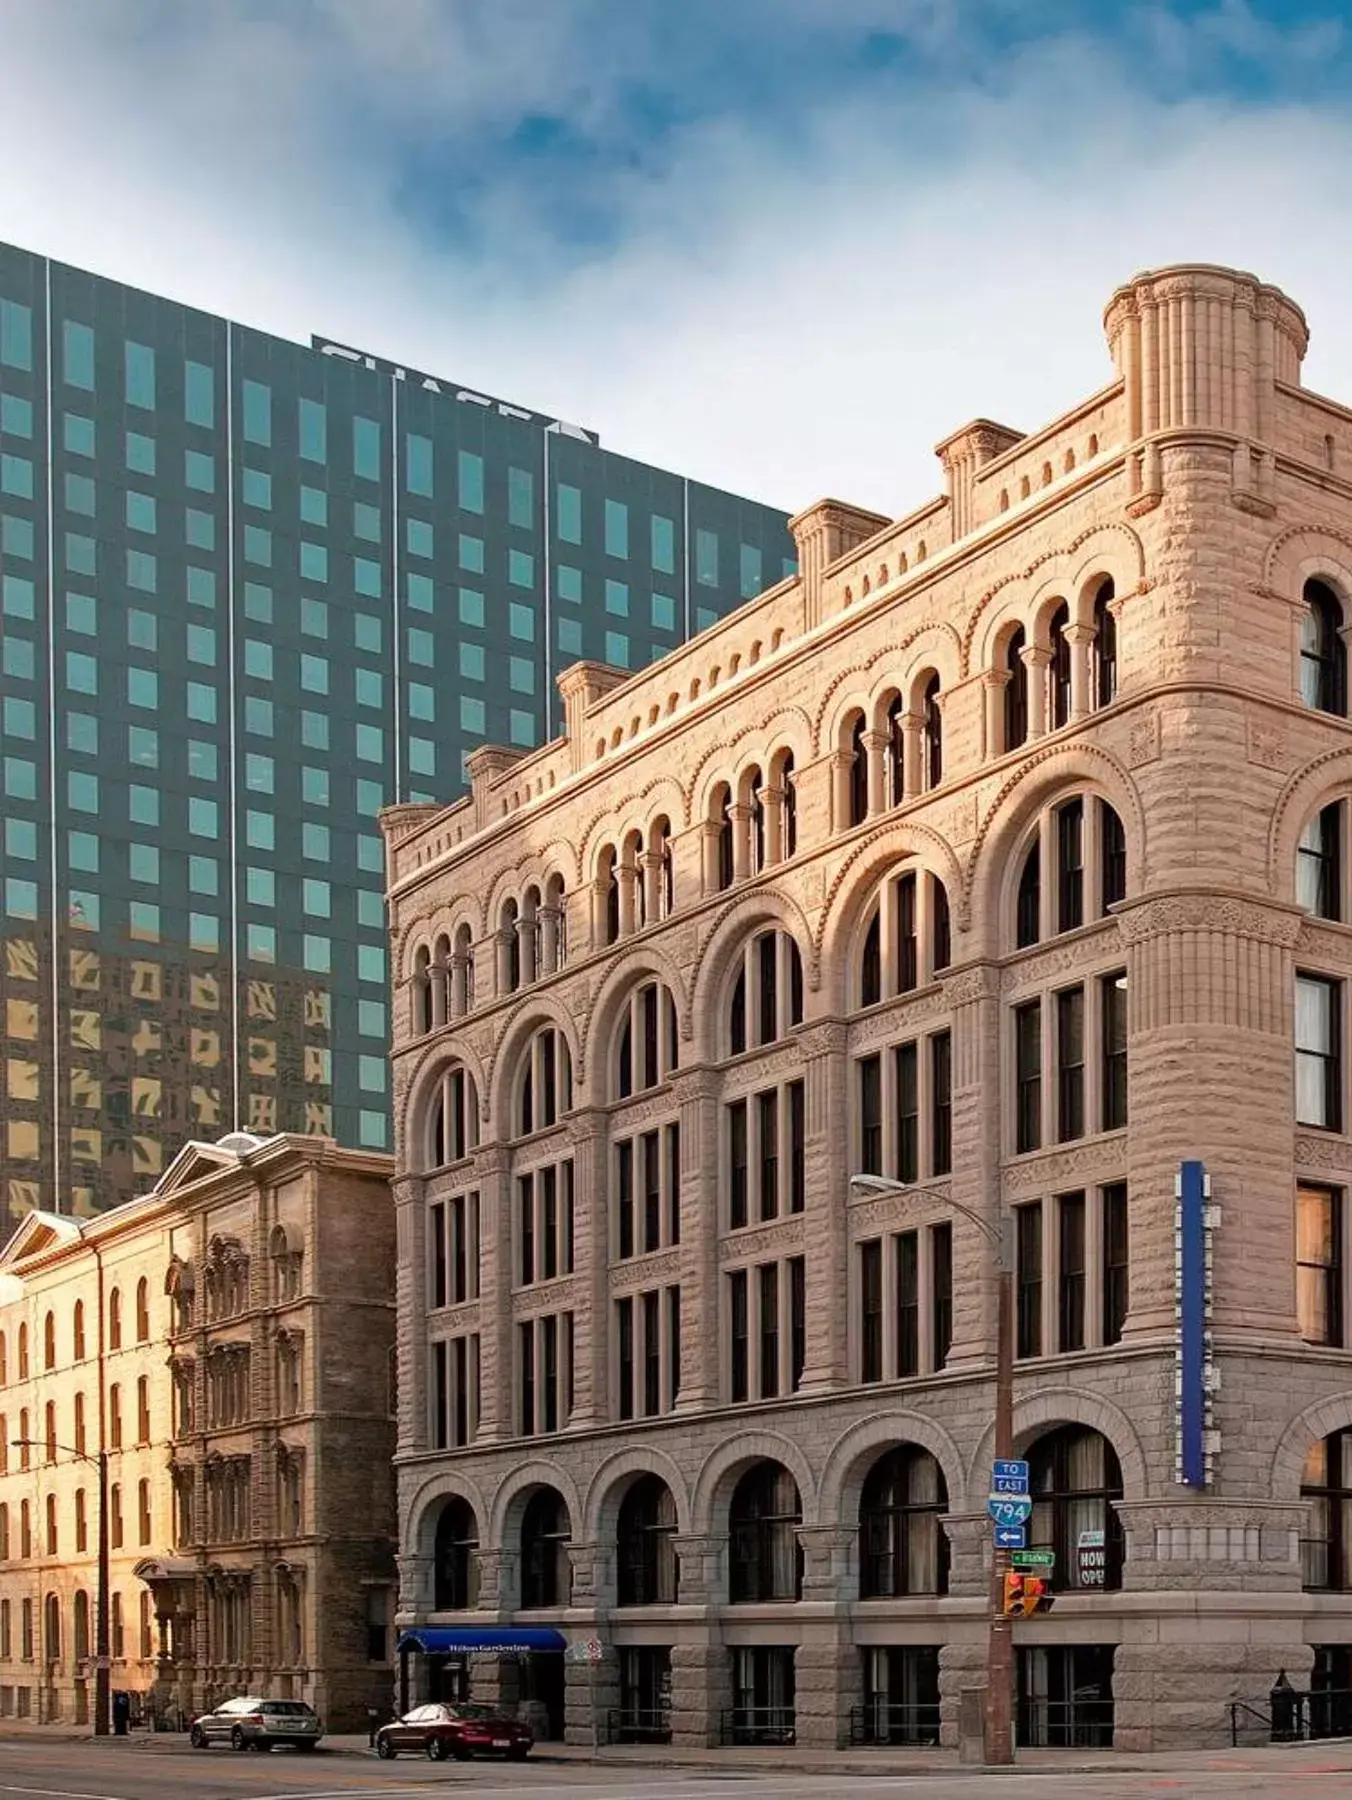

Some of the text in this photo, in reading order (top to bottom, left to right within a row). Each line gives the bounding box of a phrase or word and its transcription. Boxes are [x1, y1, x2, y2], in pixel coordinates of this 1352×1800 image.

[1002, 1464, 1018, 1474] TO
[998, 1480, 1022, 1491] EAST
[992, 1503, 1025, 1518] 794
[1081, 1570, 1105, 1585] OPE
